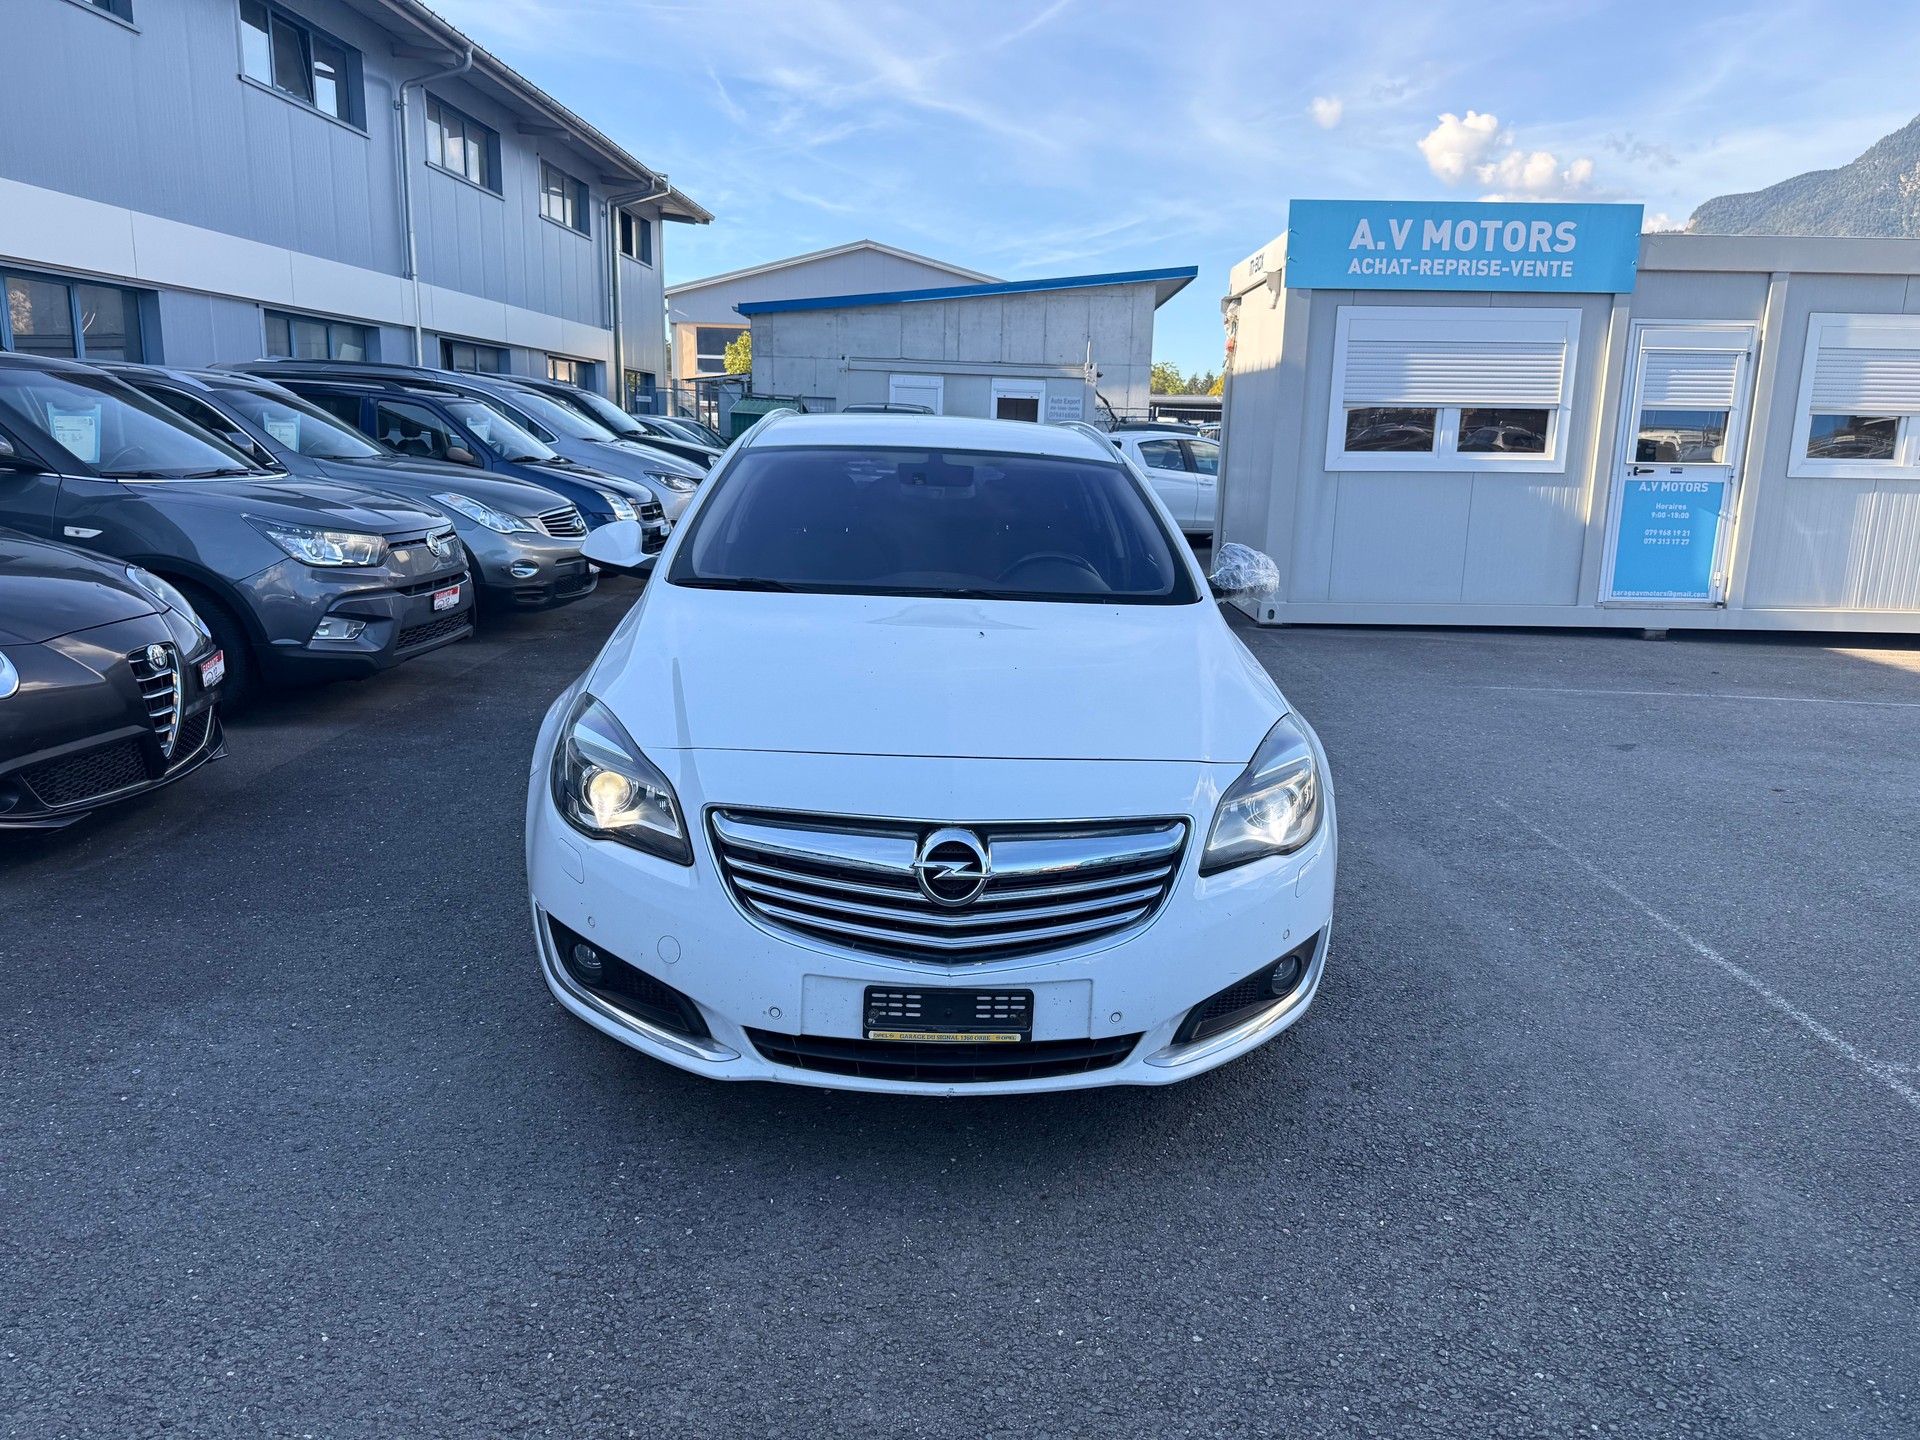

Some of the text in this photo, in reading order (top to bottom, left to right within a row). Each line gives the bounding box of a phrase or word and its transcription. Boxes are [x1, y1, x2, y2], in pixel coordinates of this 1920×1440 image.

[1349, 219, 1577, 252] A.V MOTORS
[1348, 258, 1574, 277] ACHAT-REPRISE-VENTE
[1639, 482, 1709, 492] A.V MOTORS
[1612, 590, 1708, 598] garageavmotors@gmail.com
